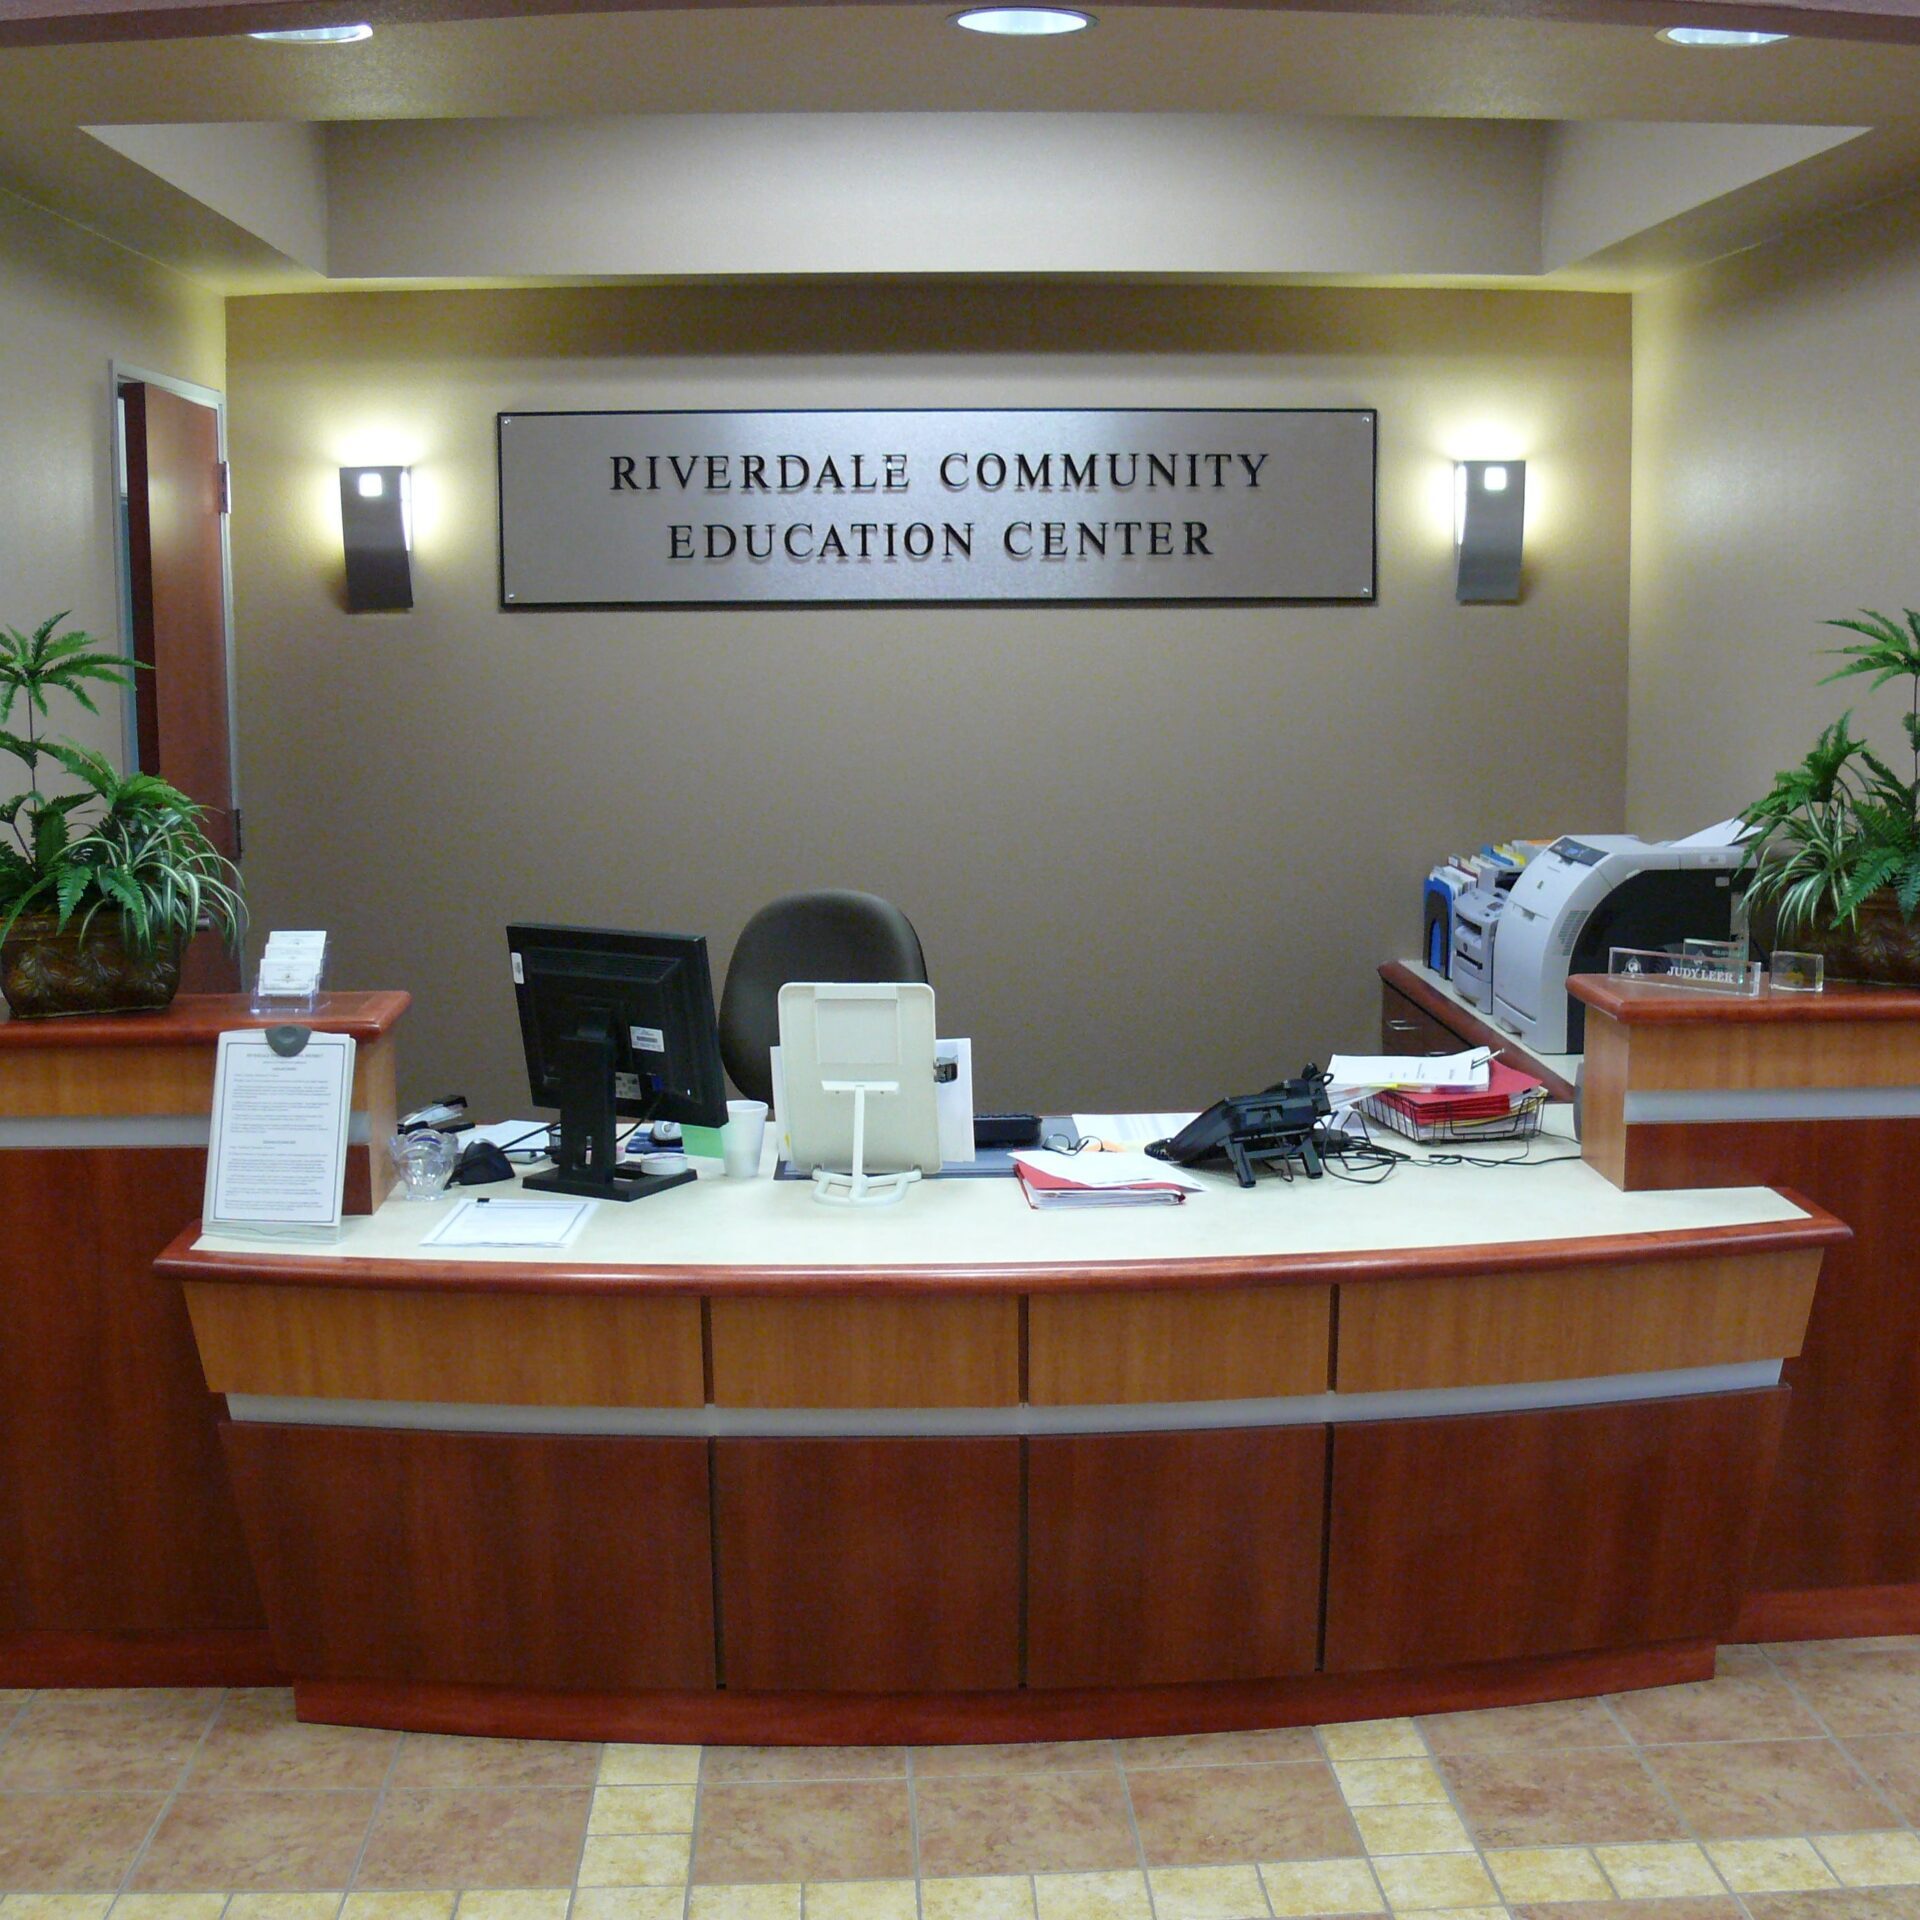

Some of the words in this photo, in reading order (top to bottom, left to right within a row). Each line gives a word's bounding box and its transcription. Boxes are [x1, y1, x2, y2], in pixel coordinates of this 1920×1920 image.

[609, 455, 910, 490] RIVERDALE
[940, 453, 1270, 488] COMMUNITY
[667, 522, 975, 558] EDUCATION
[1003, 521, 1214, 556] CENTER
[1667, 966, 1699, 980] JUDY
